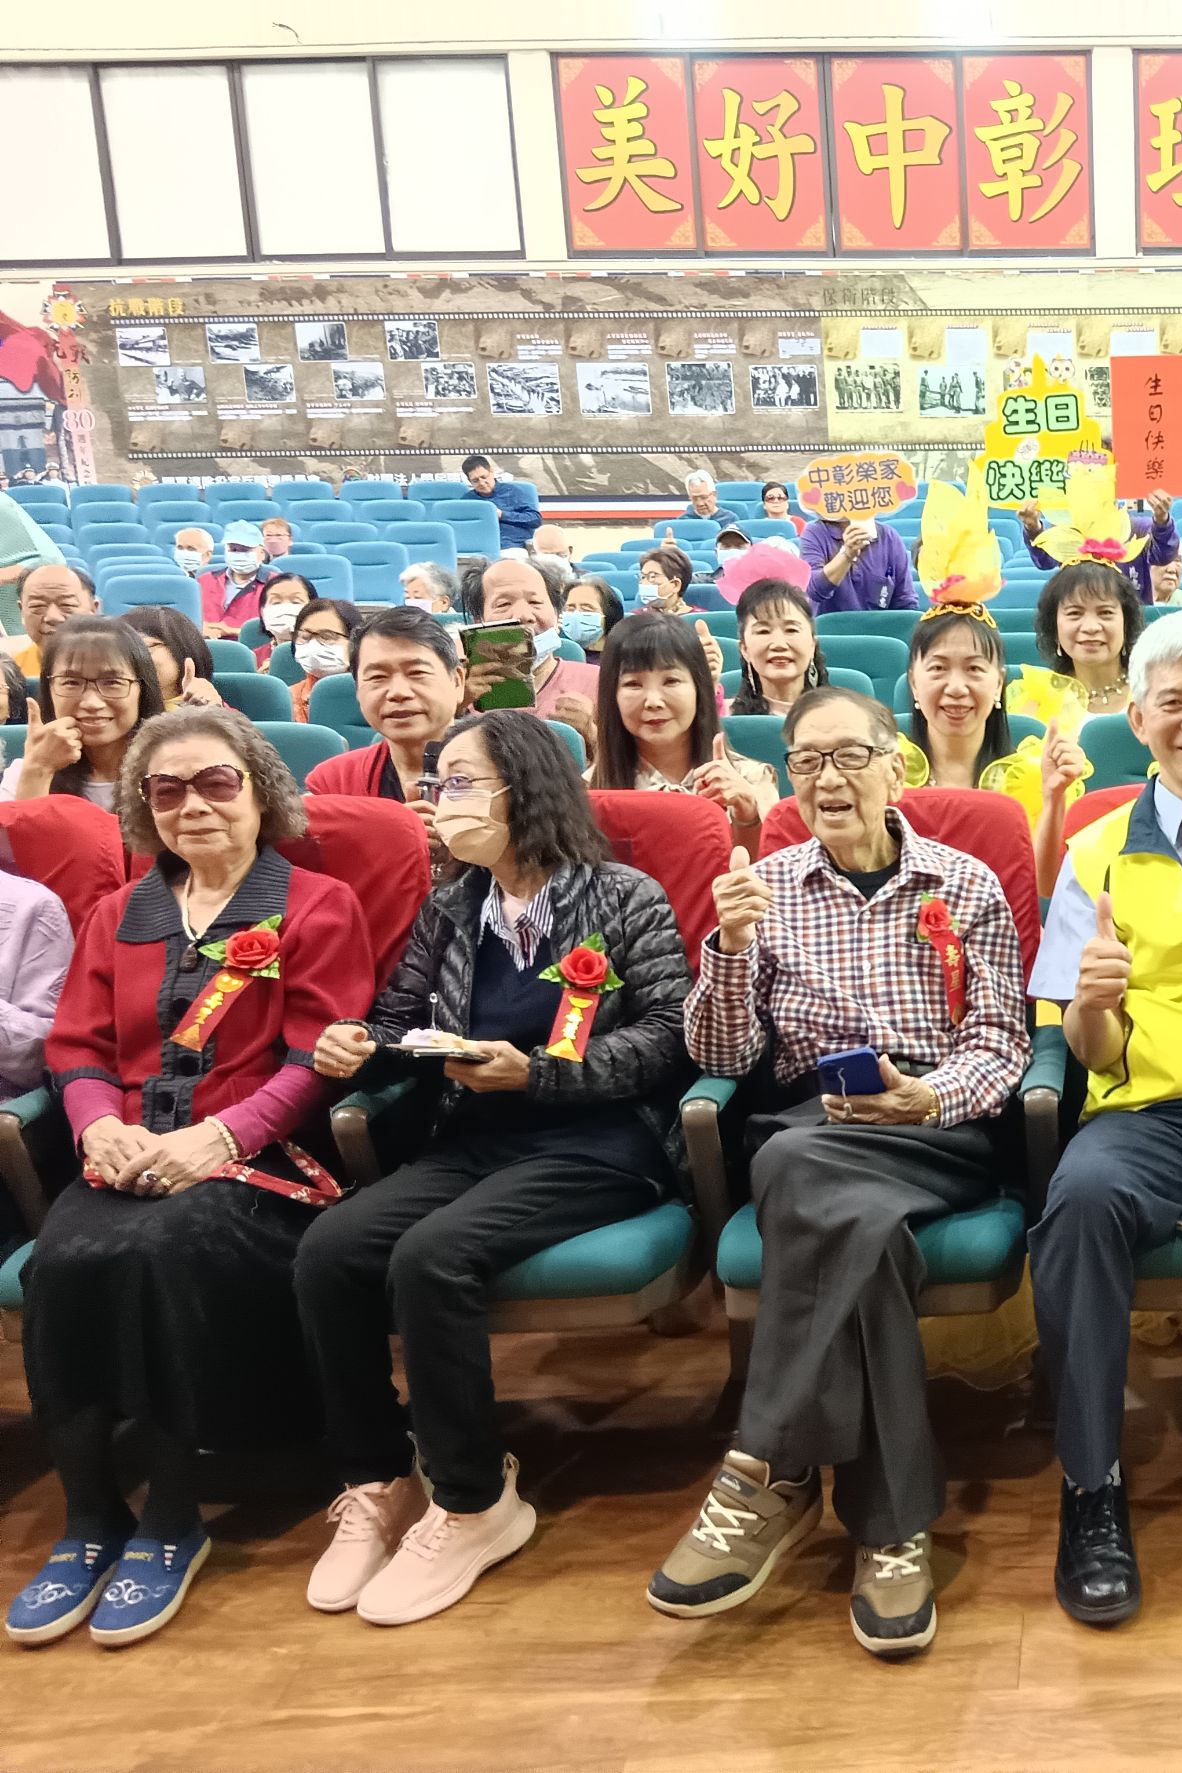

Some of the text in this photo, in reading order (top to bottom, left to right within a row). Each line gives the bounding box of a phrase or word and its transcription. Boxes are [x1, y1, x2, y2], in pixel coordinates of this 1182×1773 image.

[574, 76, 1083, 228] 美好中彰
[63, 409, 95, 432] 80
[1002, 393, 1080, 435] 生日
[1144, 373, 1165, 480] 生日快樂
[808, 458, 902, 488] 中彰榮家
[823, 485, 894, 514] 歡迎您
